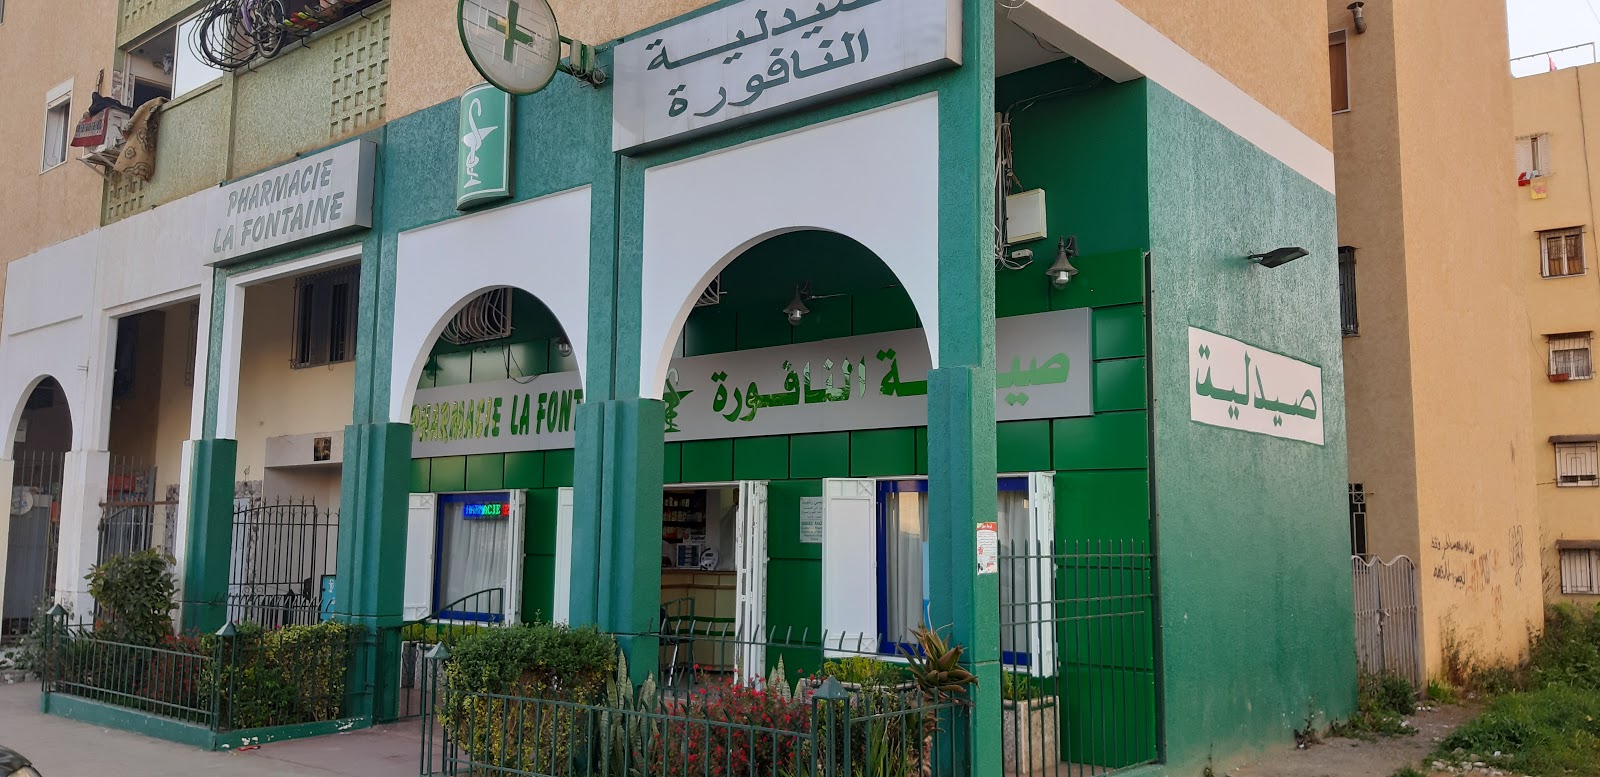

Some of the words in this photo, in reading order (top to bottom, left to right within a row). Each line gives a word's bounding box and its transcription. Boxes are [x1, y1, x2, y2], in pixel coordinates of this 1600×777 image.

[668, 27, 870, 118] النافورة
[227, 158, 333, 217] PHARMACIE
[213, 224, 234, 253] LA
[241, 191, 344, 247] FONTAINE
[710, 355, 867, 422] النافورة
[1195, 343, 1317, 427] صيدلية
[411, 397, 502, 443] PHARMACIE
[511, 394, 530, 435] LA
